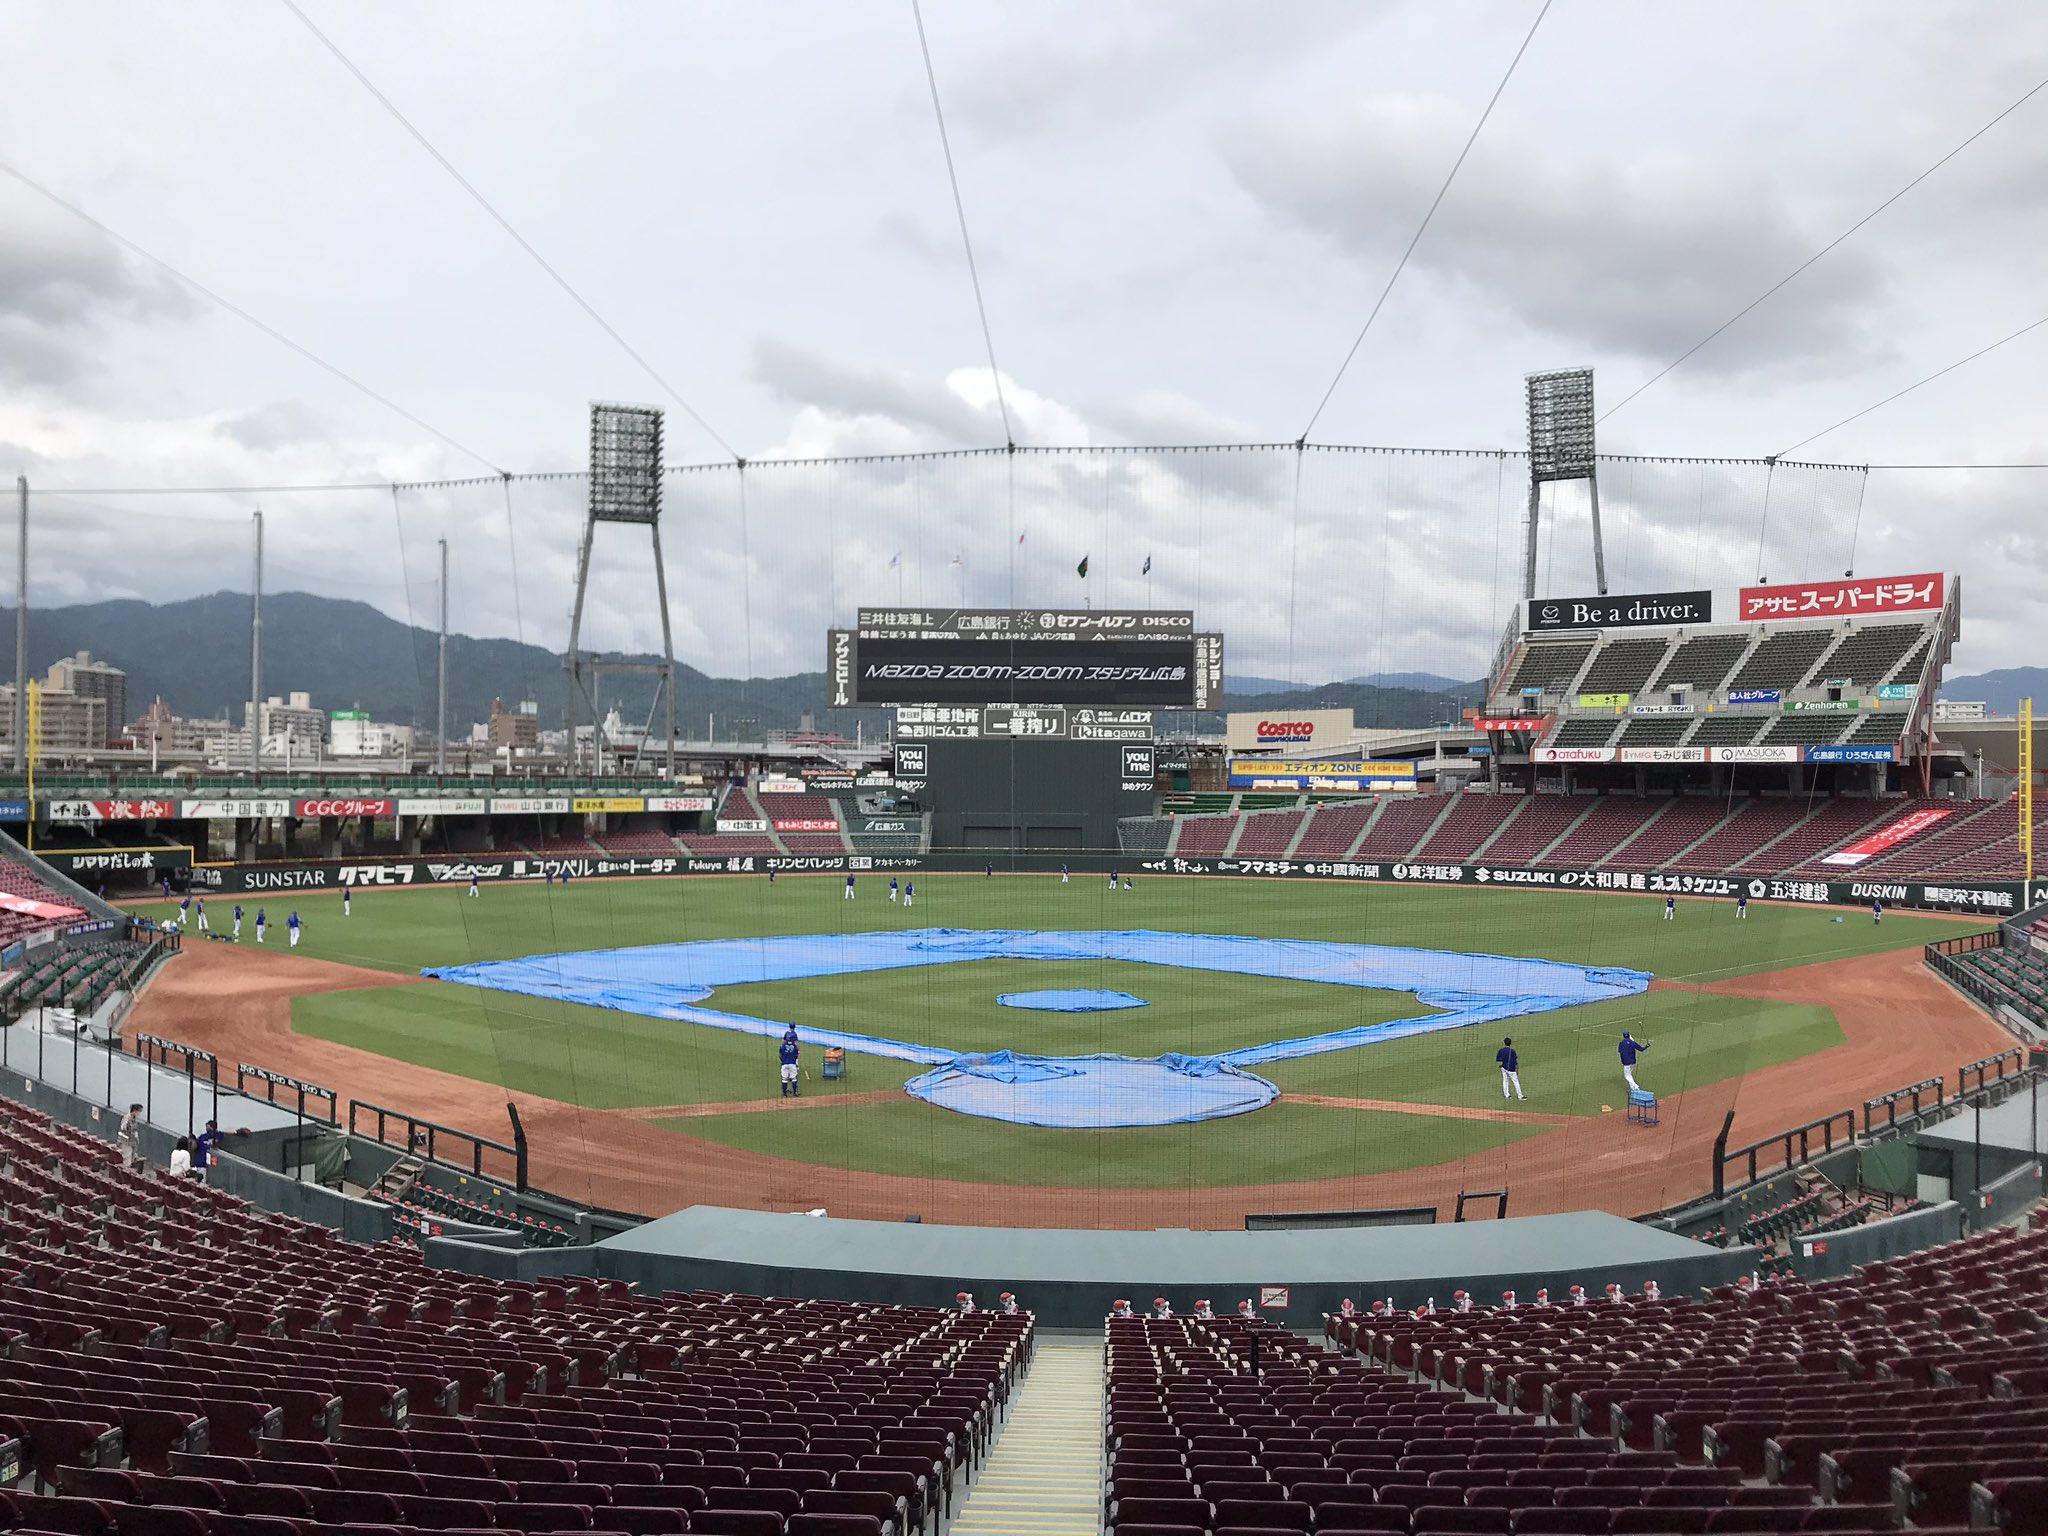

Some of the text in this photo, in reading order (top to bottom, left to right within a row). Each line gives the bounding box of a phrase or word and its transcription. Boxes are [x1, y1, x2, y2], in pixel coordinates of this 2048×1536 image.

[860, 613, 934, 625] 三井住友海上
[1572, 600, 1699, 624] Be a driver.
[958, 616, 1010, 630] 広島銀行
[1143, 617, 1190, 626] DISCO
[834, 633, 850, 706] アサヒビール
[1084, 666, 1187, 681] スタジアム広島
[1195, 638, 1208, 709] 広島市信用組合
[1804, 700, 1848, 710] Zenhoren
[922, 709, 980, 723] 東亜地所
[1013, 710, 1038, 718] KIRIN
[1118, 711, 1153, 723] ムロオ
[913, 725, 980, 738] 西川ゴム工業
[991, 718, 1058, 735] 一番搾り
[1257, 721, 1314, 737] COSTCO
[899, 748, 923, 761] you
[1125, 750, 1149, 764] you
[1652, 750, 1702, 760] もみじ銀行
[1735, 748, 1786, 758] MASUOKA
[1812, 750, 1891, 760] 広島銀行 ひろぎん証券
[903, 760, 924, 771] me
[1130, 762, 1150, 772] me
[1285, 763, 1362, 773] エディオン ZONE
[1122, 781, 1154, 792] ゆめタウン
[221, 801, 284, 816] 中国電力
[303, 800, 386, 816] CGCグループ
[521, 802, 566, 812] 山口銀行
[575, 802, 606, 810] 東洋水産
[874, 822, 906, 832] 広島ガス
[72, 851, 154, 870] シマヤだしの素
[688, 857, 755, 872] Fukuya 福屋
[766, 857, 844, 869] キリンビバレッジ
[873, 858, 922, 867] タカキベーカリー
[1239, 860, 1299, 875] フマキラー
[338, 865, 415, 886] クマヒラ
[531, 858, 594, 880] ユウベル
[1408, 865, 1463, 880] 東洋証券
[244, 870, 325, 888] SUNSTAR
[1493, 870, 1556, 883] SUZUKI
[1580, 871, 1646, 890] 大和興産
[1770, 881, 1829, 902] 五洋建設
[1851, 883, 1908, 900] DUSKIN
[1939, 889, 2014, 908] 章栄不動産
